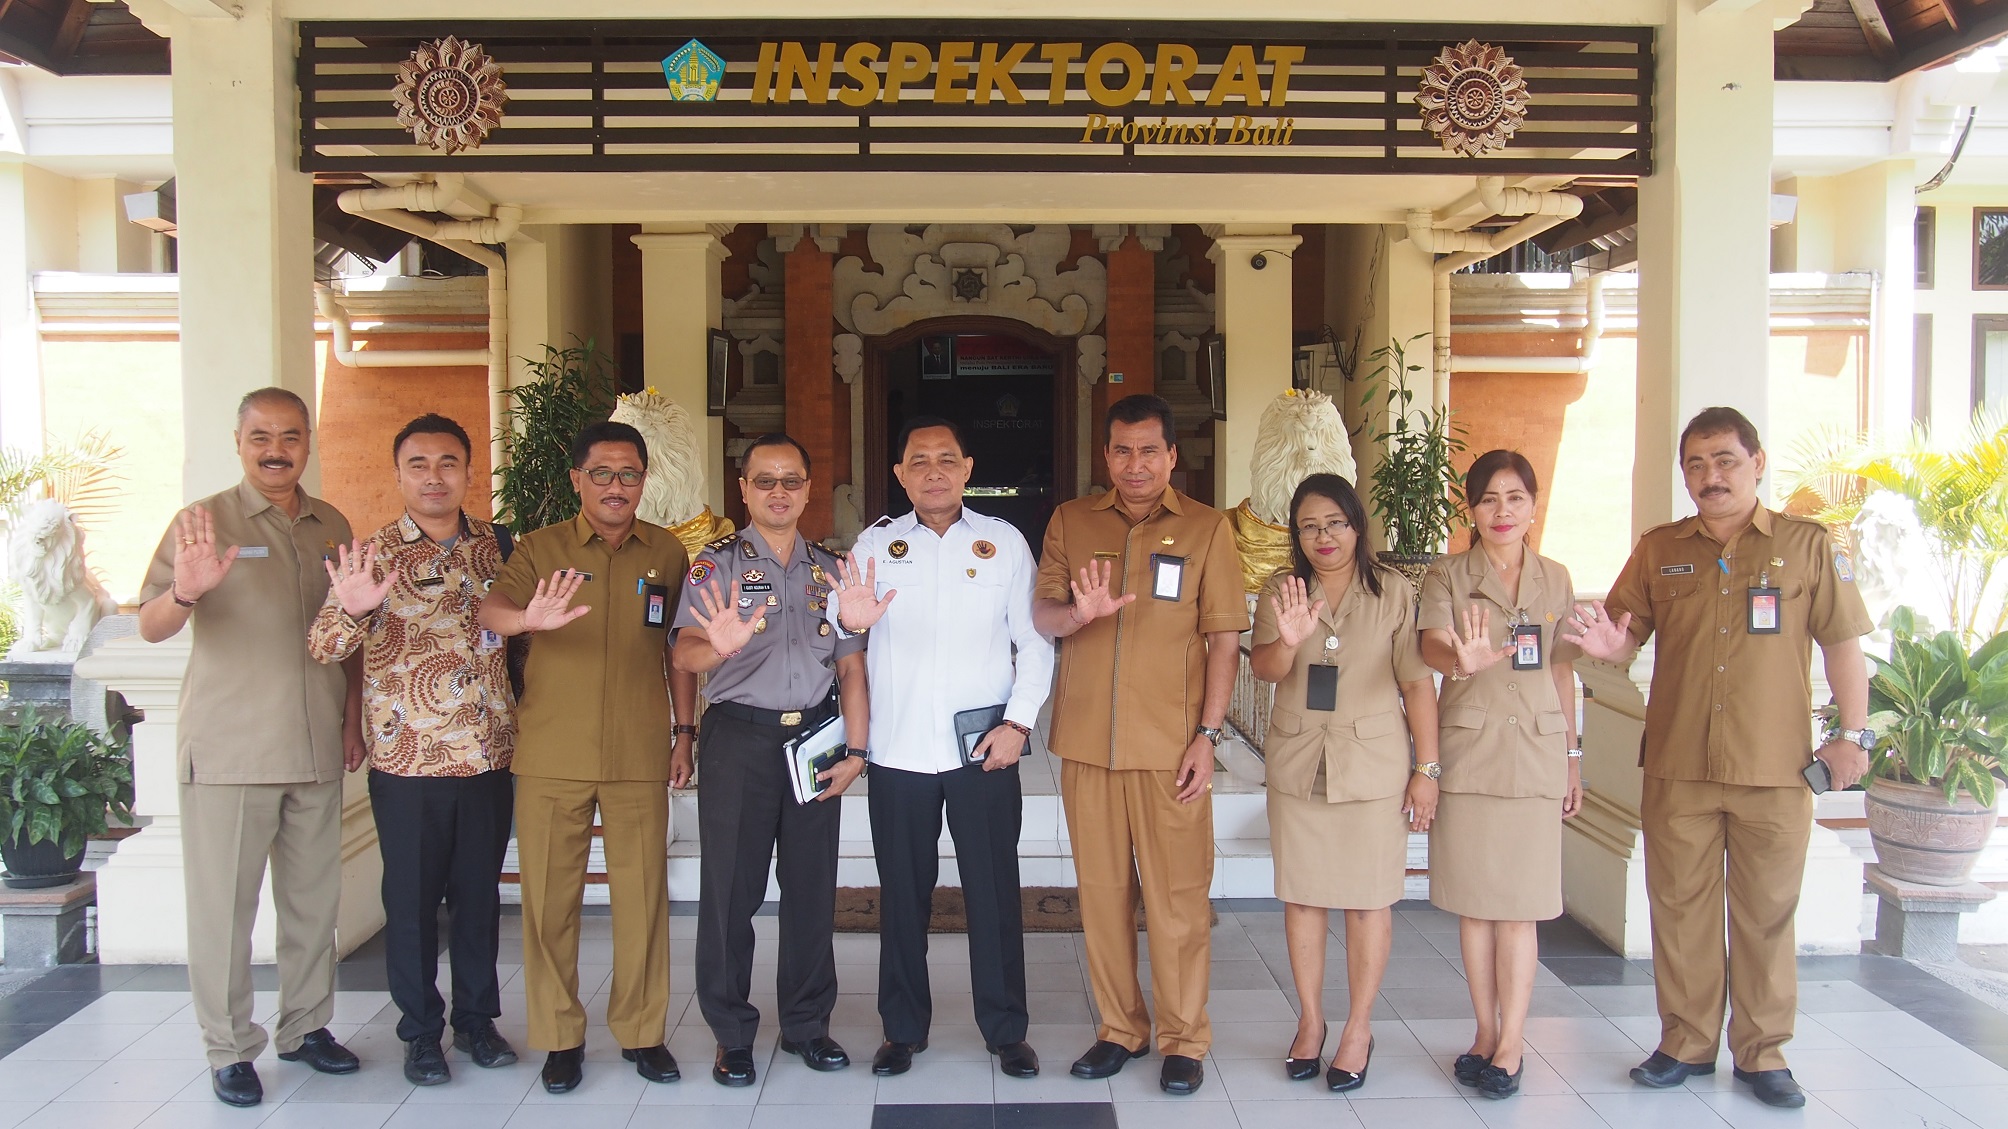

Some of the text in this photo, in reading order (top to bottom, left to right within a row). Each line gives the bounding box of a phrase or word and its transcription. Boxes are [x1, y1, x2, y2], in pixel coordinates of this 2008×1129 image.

[750, 41, 1306, 107] INSPEKTORAT
[1080, 113, 1295, 147] Provinsi Bali
[973, 418, 1044, 429] INSPEKTORAT
